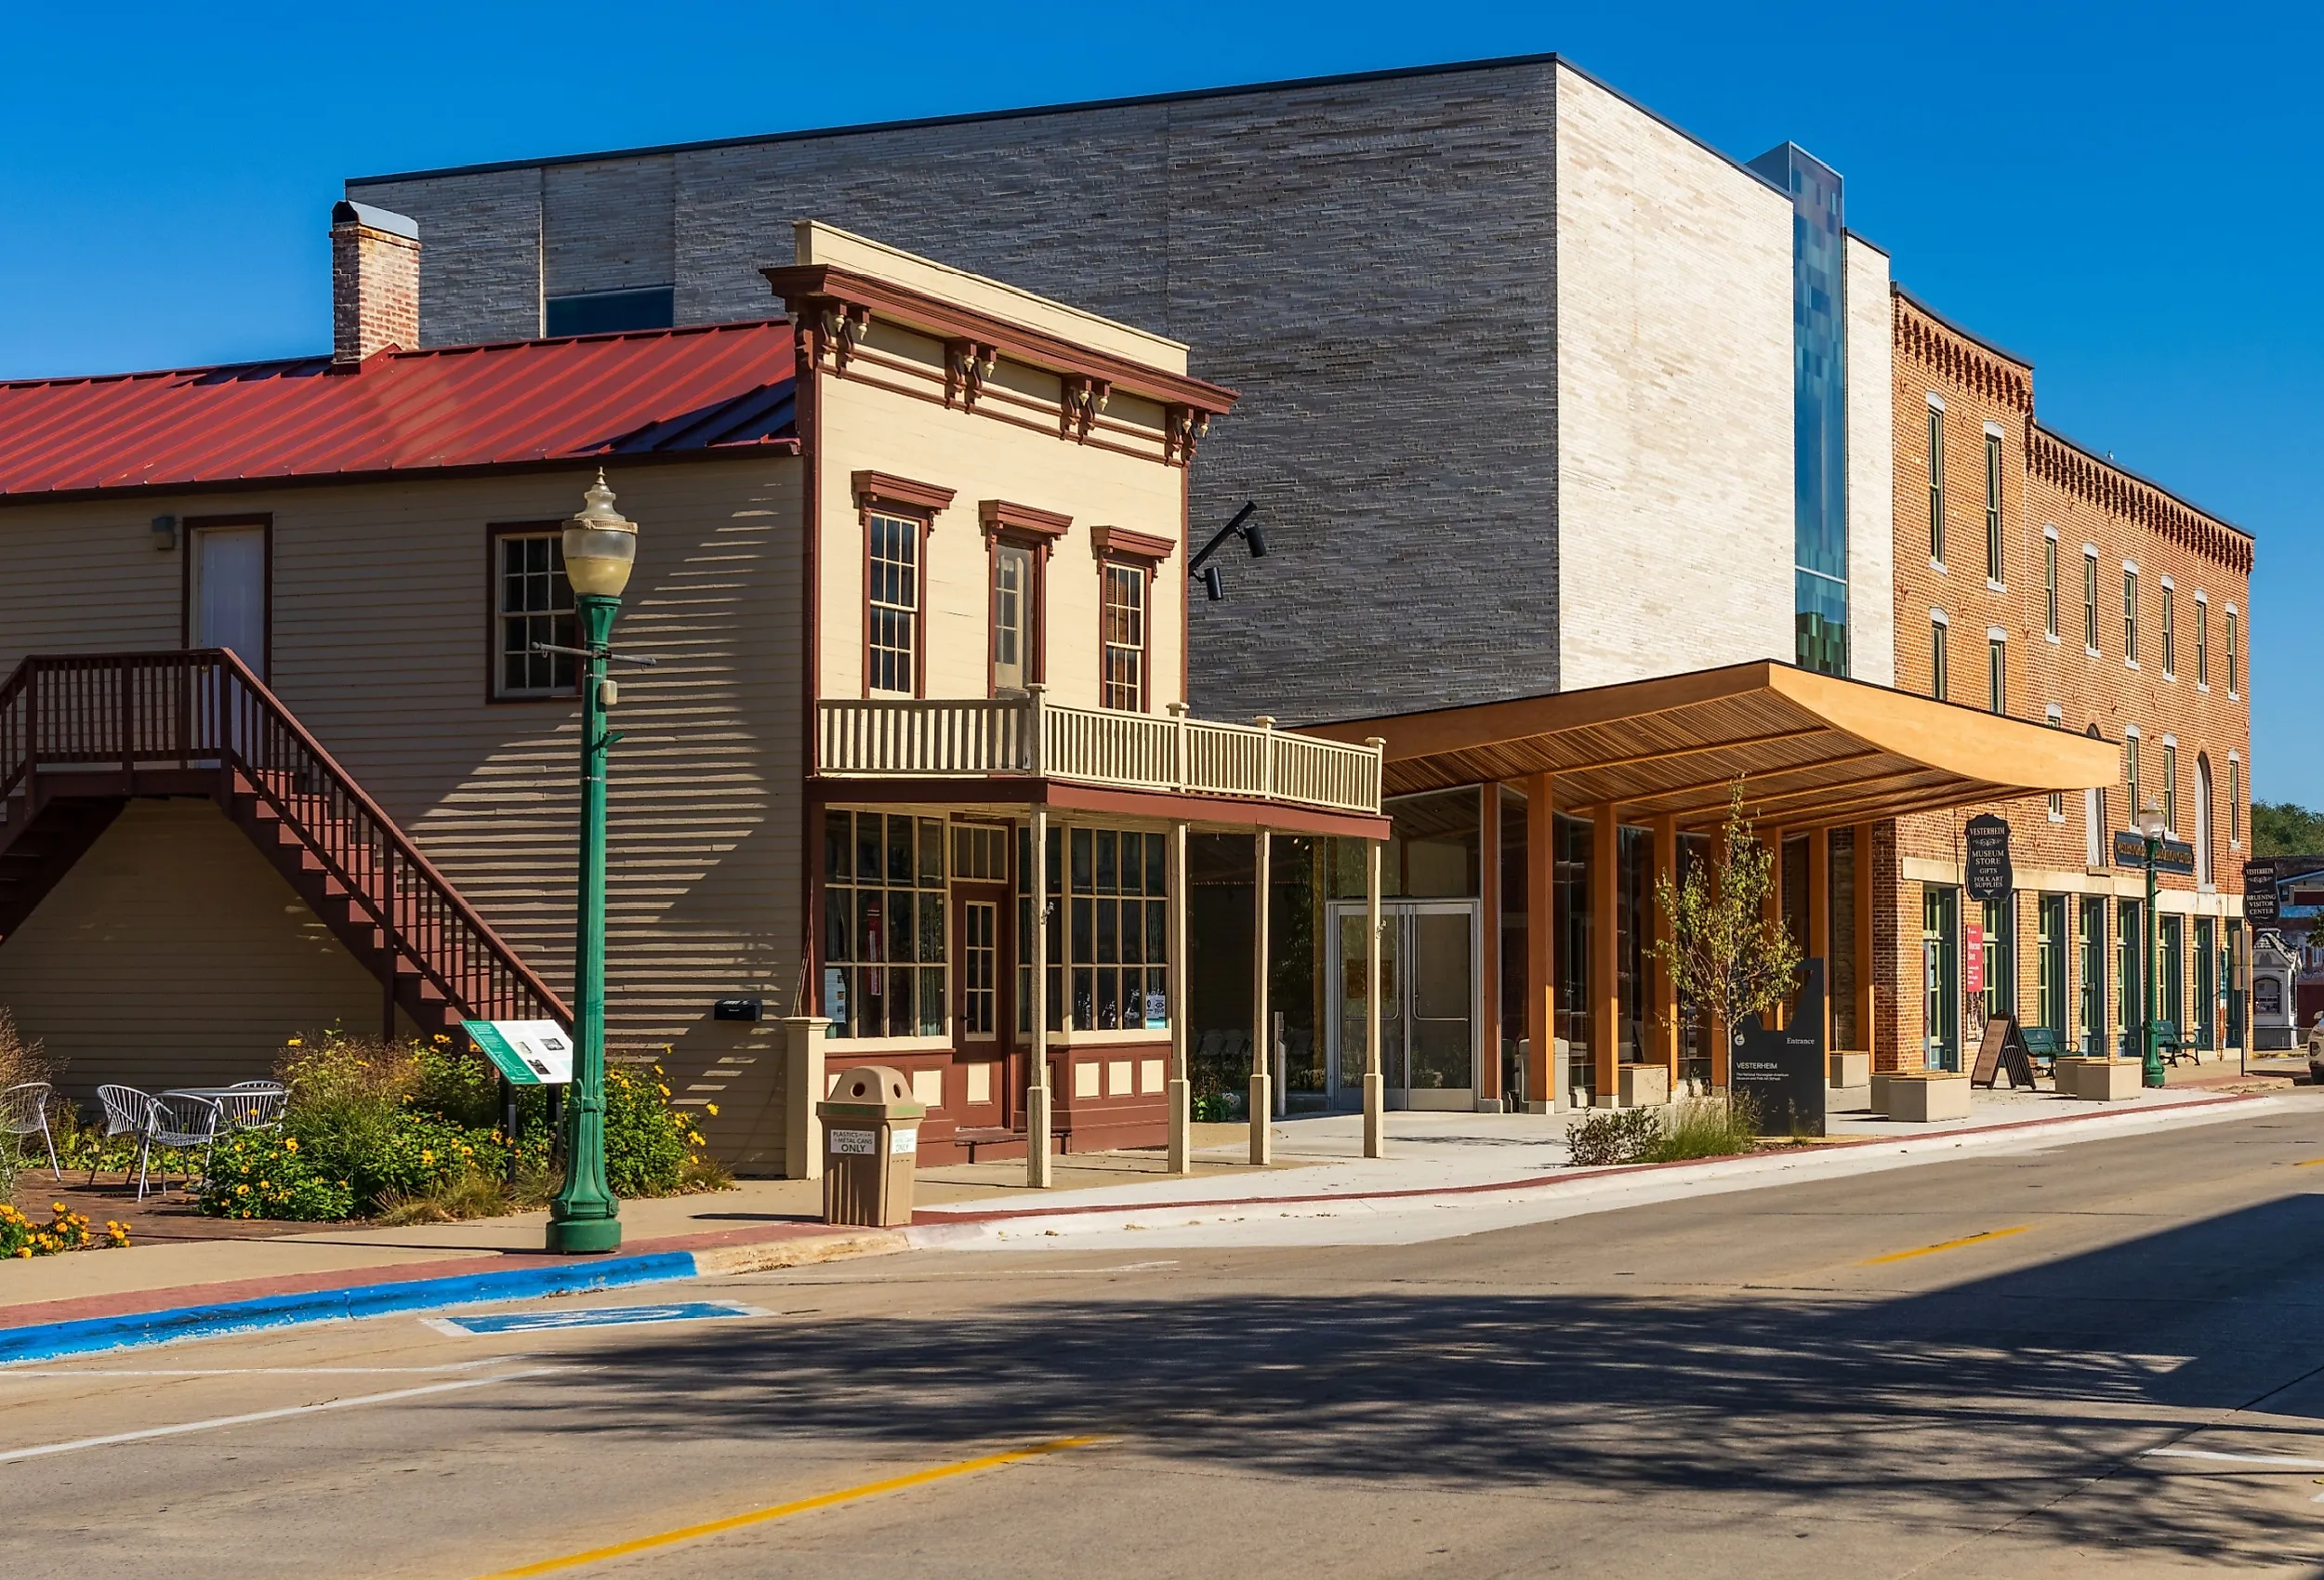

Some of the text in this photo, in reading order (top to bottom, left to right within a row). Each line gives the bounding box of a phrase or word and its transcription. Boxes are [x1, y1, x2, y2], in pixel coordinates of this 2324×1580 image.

[1970, 827, 2005, 836] VESTERHEIM
[841, 1144, 865, 1152] ONLY
[895, 1144, 909, 1152] ONLY
